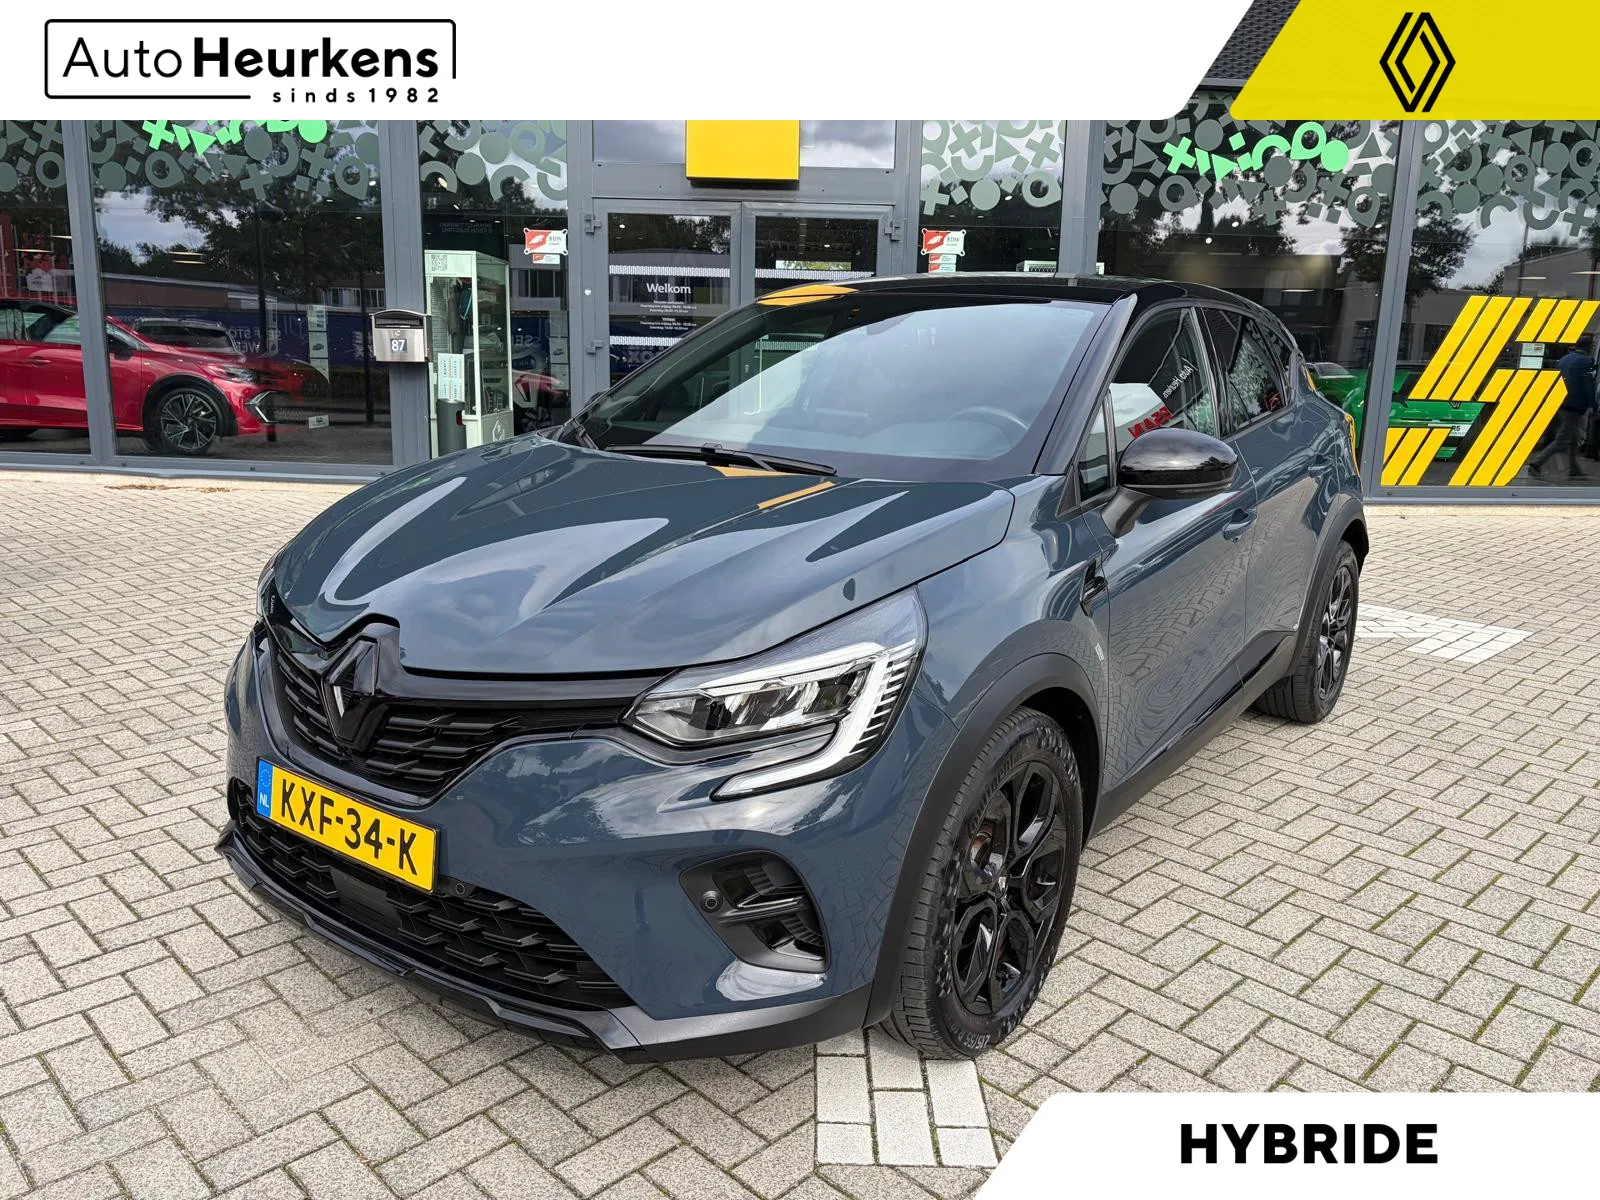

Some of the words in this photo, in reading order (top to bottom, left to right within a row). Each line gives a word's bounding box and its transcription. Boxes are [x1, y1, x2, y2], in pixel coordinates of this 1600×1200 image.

[646, 283, 691, 294] Welkom
[391, 340, 406, 352] 87
[259, 791, 270, 808] NL
[281, 778, 418, 876] KXF-34-K
